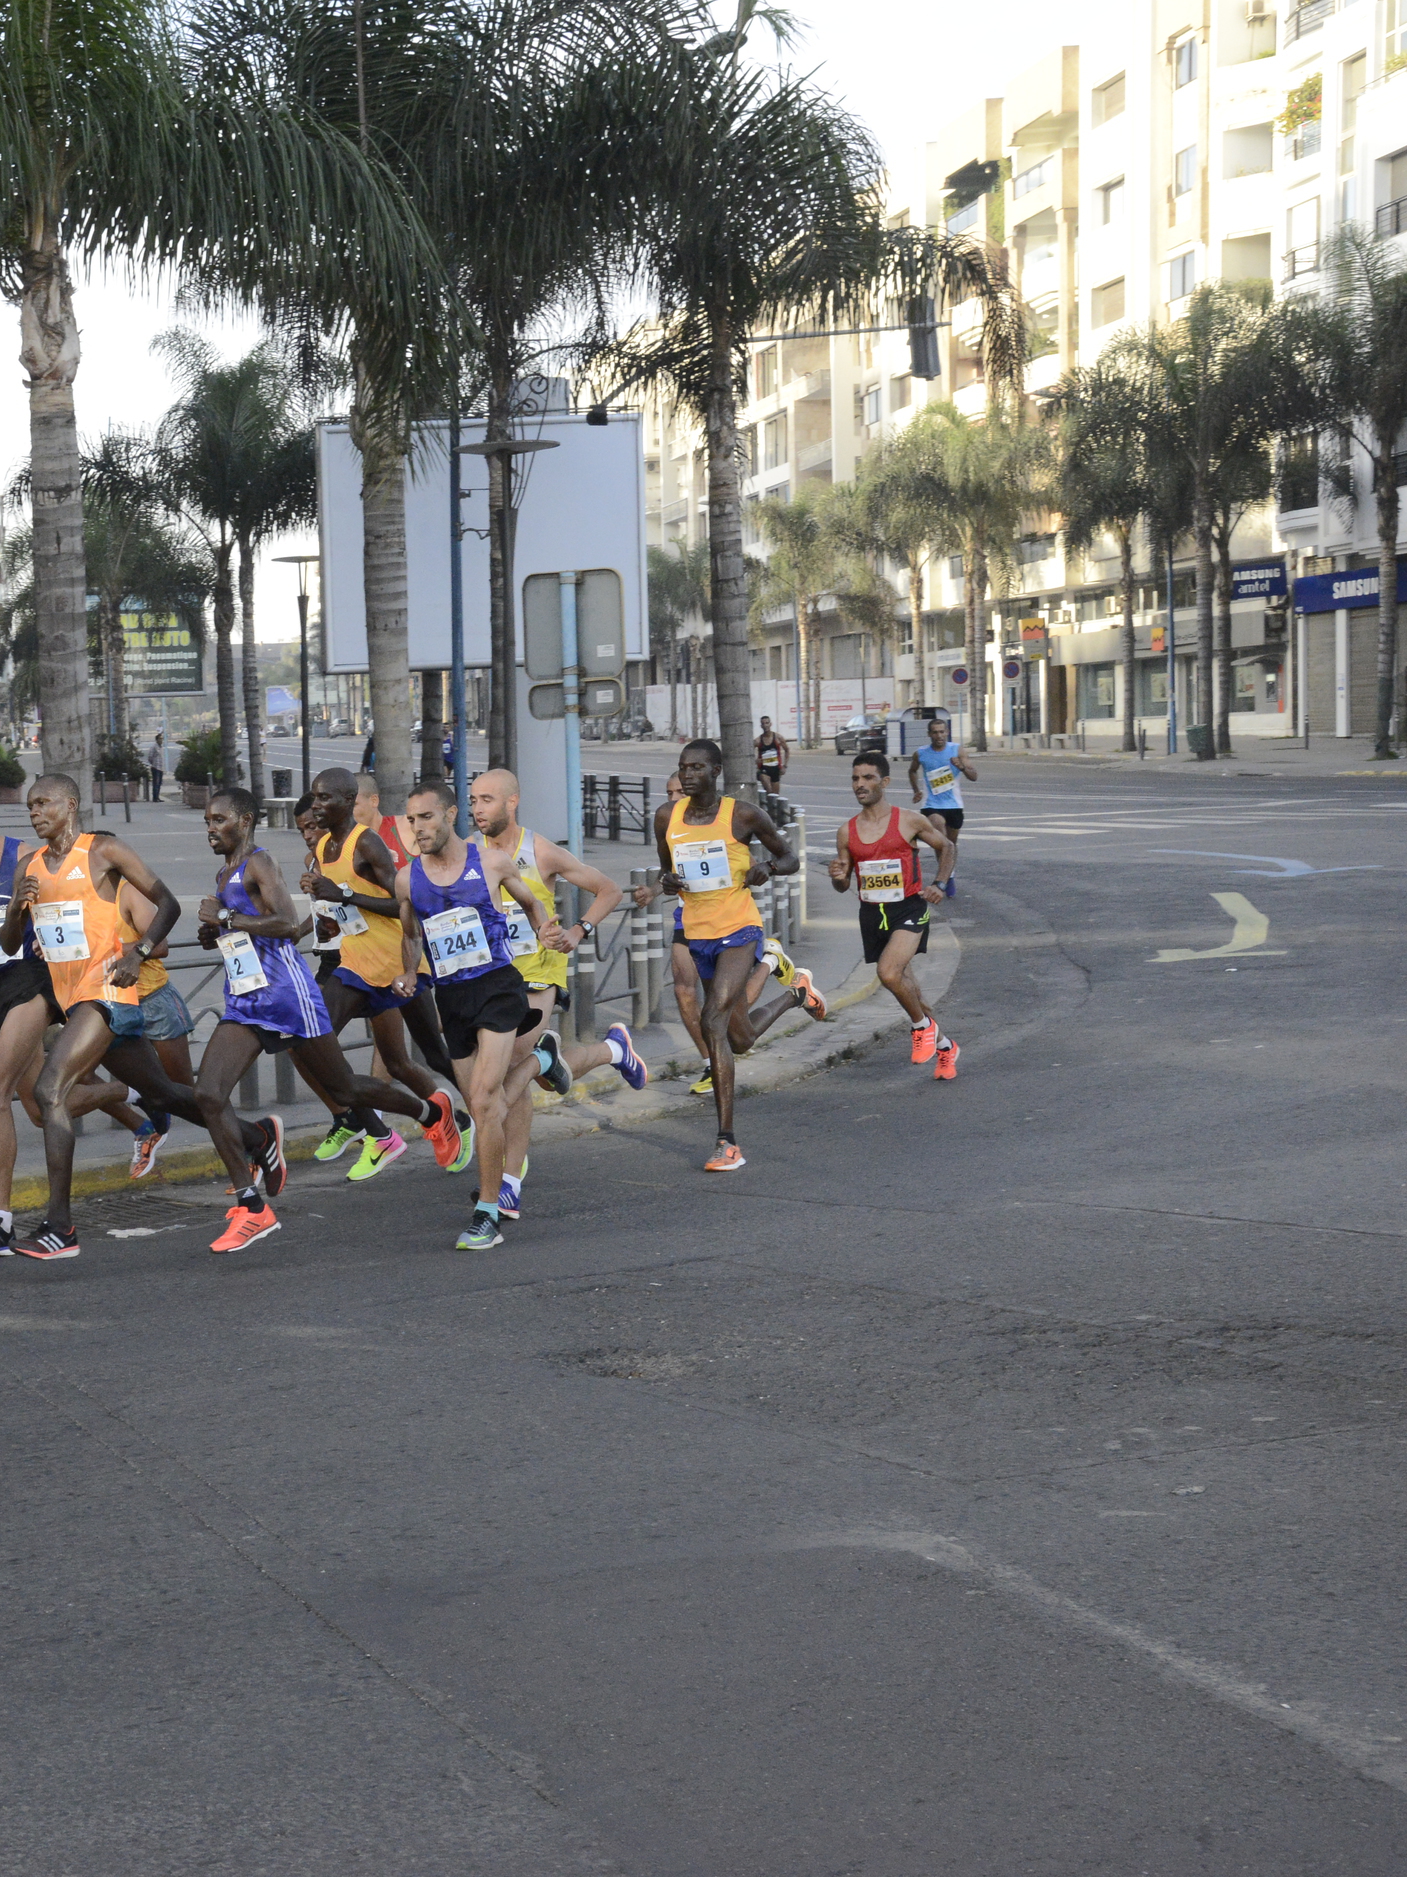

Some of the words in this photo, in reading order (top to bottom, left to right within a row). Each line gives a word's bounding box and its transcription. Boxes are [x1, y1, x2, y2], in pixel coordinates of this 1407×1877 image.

[1232, 568, 1281, 581] AMSUNG
[1332, 577, 1380, 600] SAMSUN
[700, 861, 710, 876] 9
[867, 874, 900, 889] 3564
[55, 926, 65, 944] 3
[444, 931, 477, 955] 244
[234, 957, 244, 976] 2
